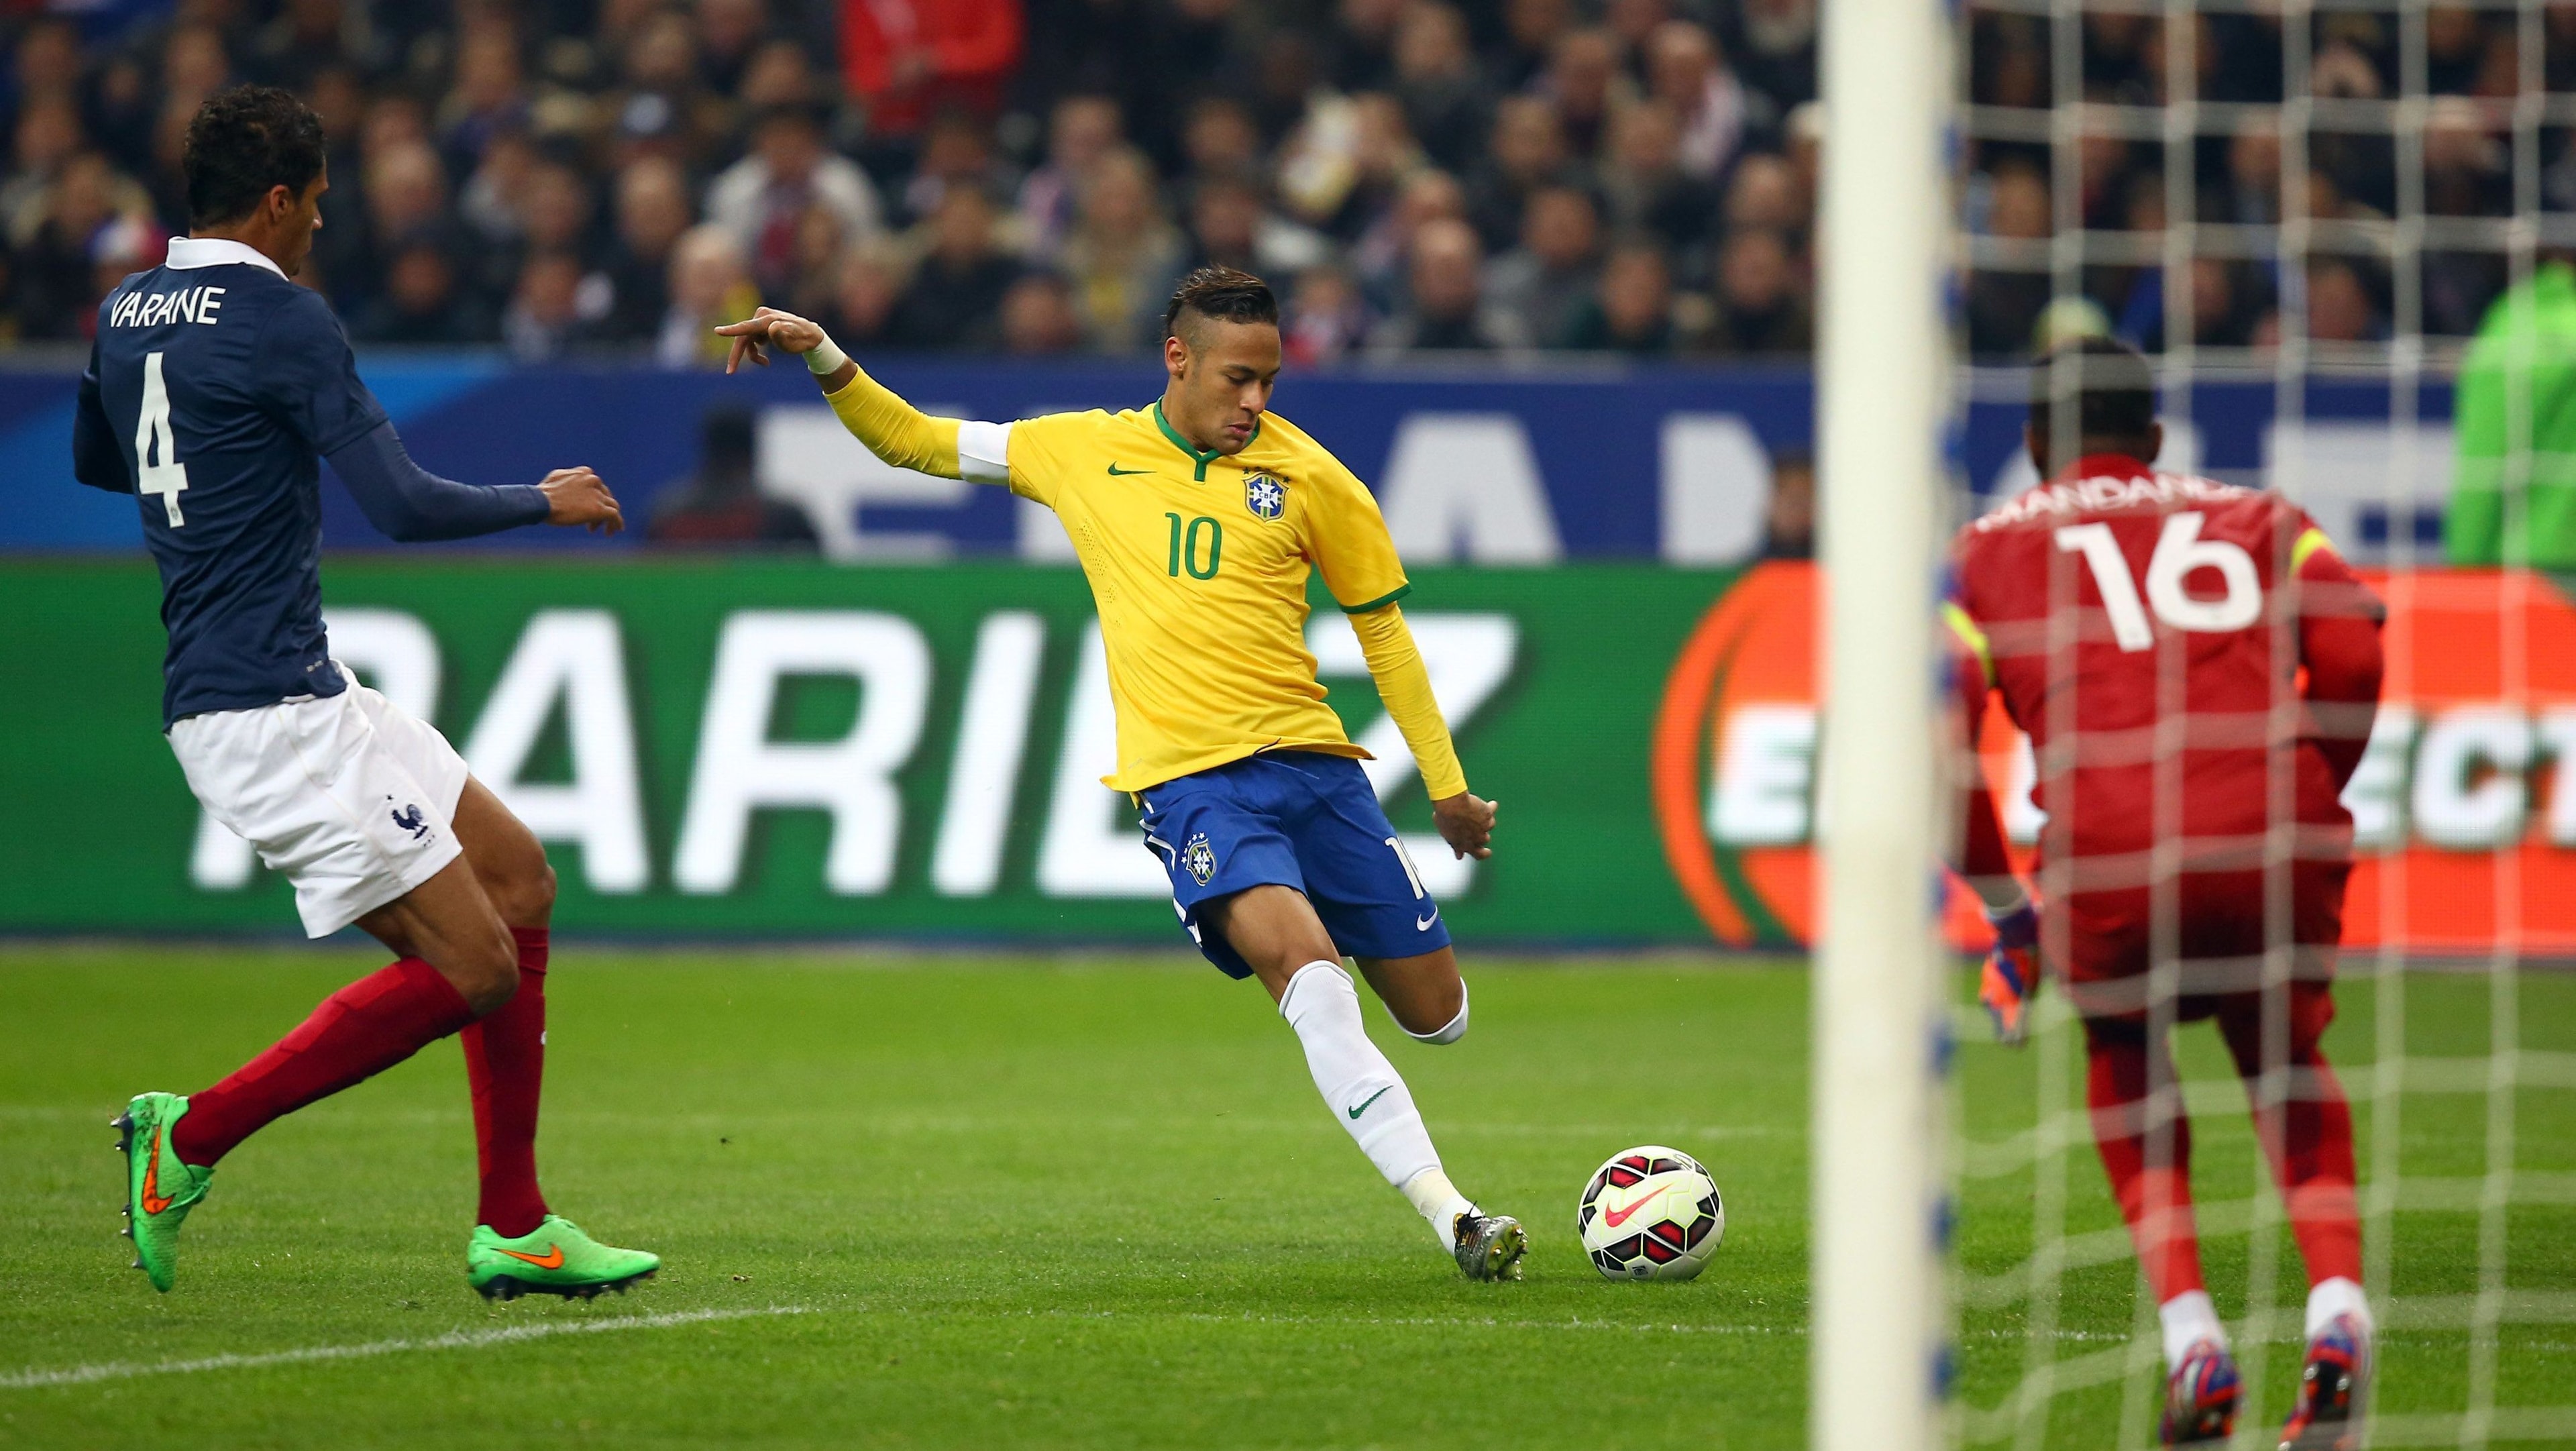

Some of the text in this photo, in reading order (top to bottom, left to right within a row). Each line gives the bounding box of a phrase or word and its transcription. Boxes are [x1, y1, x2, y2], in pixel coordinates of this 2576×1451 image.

[111, 286, 226, 327] VARANE
[136, 352, 189, 529] 4
[1258, 492, 1274, 500] CBF
[1165, 512, 1222, 580] 10
[2054, 510, 2263, 653] 16
